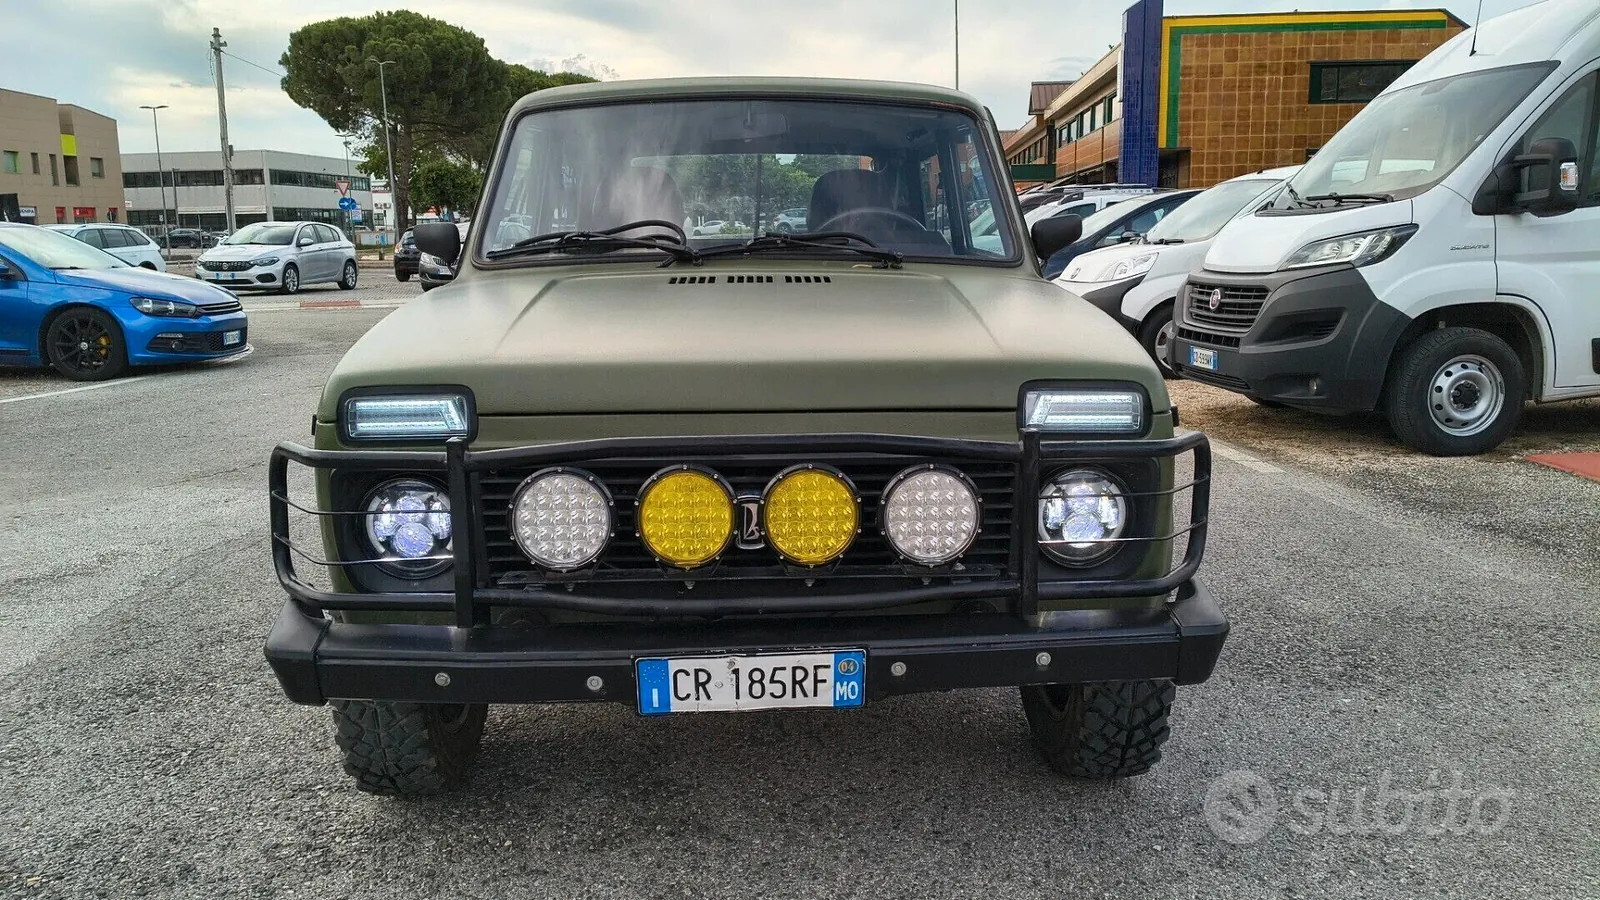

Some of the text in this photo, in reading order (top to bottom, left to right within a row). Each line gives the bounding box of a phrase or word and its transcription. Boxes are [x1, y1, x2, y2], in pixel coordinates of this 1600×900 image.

[839, 660, 856, 672] 04
[672, 664, 832, 701] CR 185RF
[835, 681, 859, 701] MO
[652, 688, 659, 708] I
